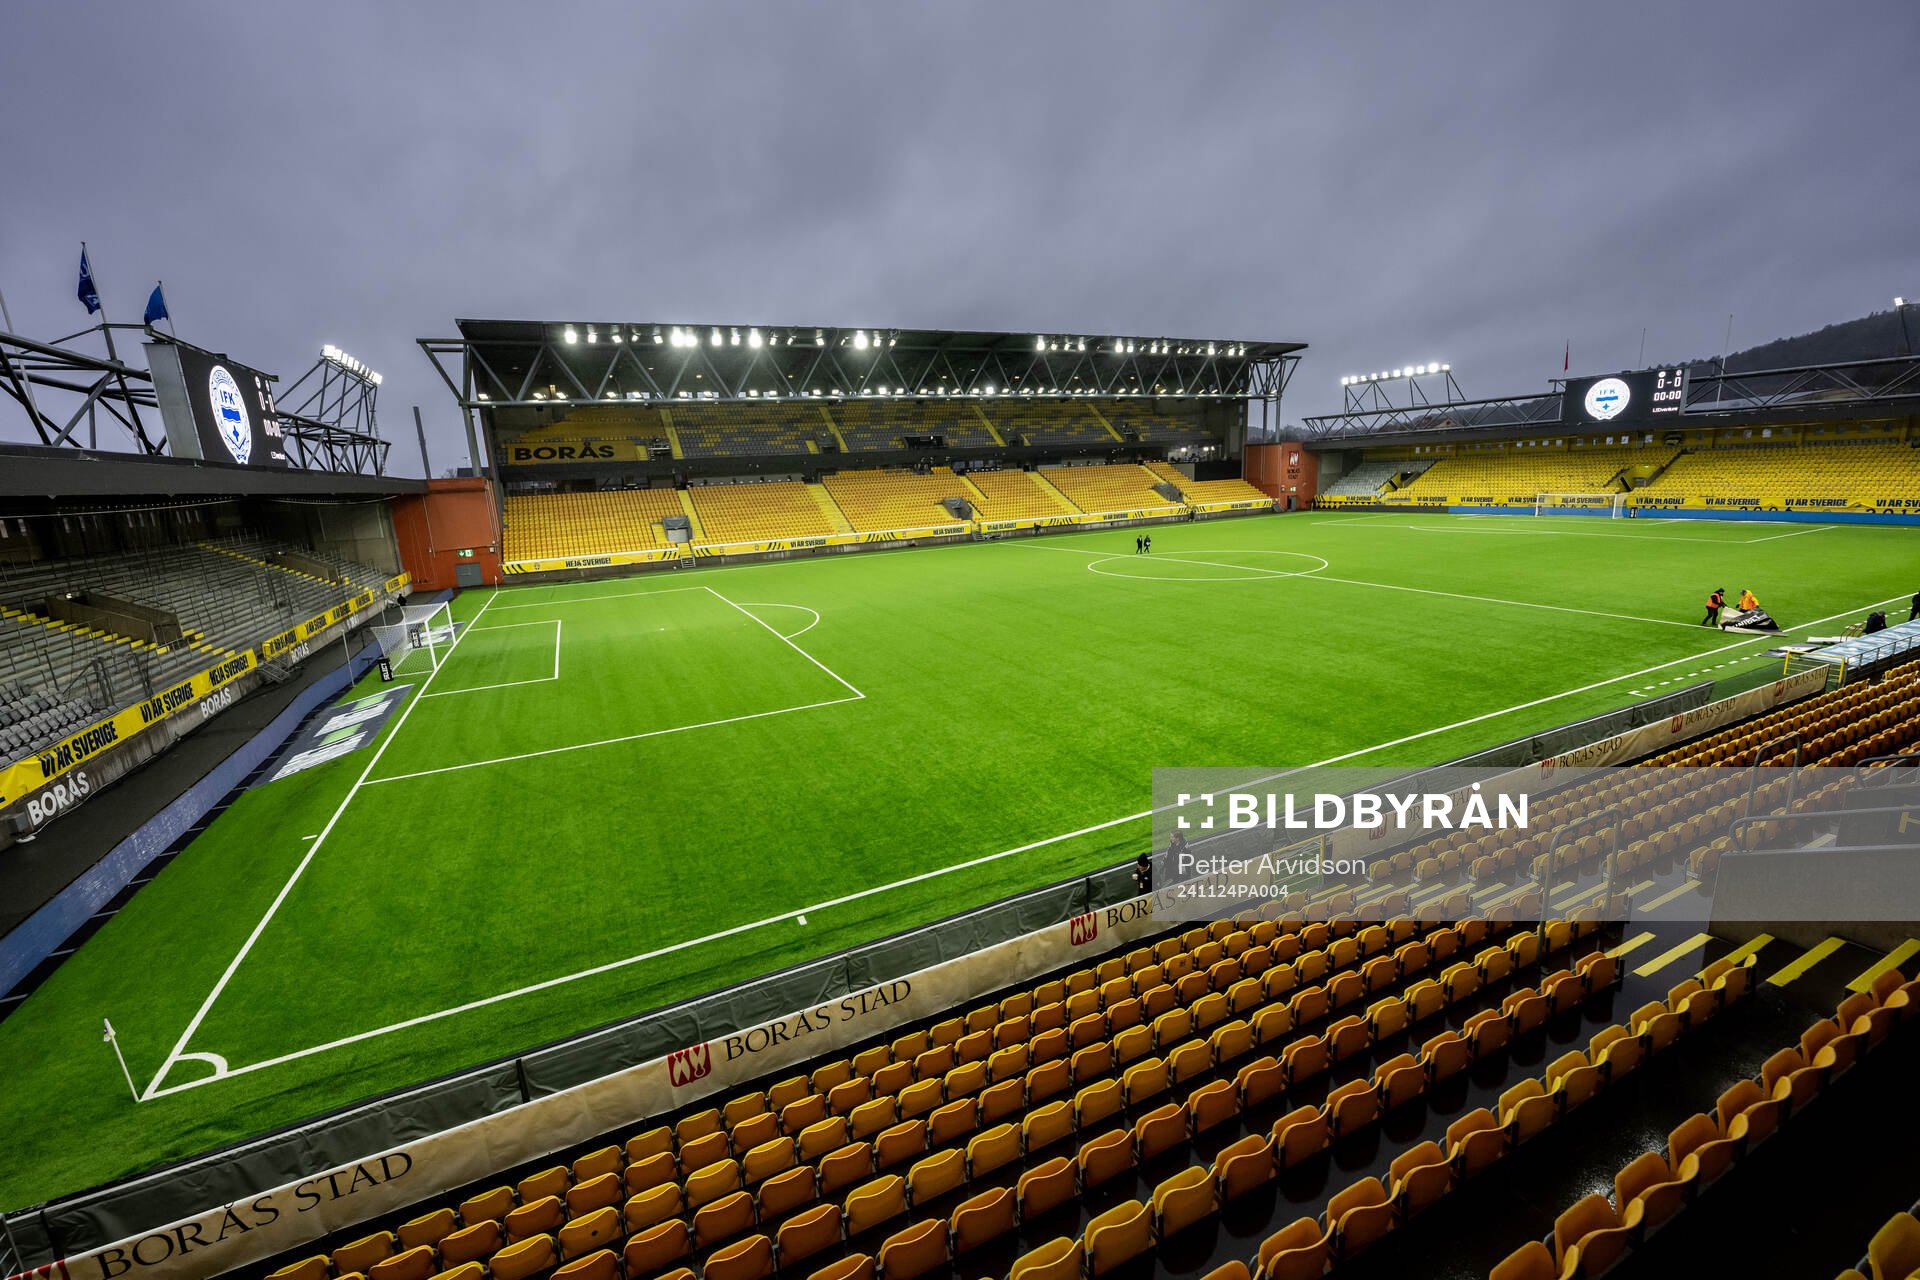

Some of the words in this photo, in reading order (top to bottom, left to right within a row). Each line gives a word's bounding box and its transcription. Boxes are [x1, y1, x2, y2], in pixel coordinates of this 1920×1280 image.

[220, 389, 236, 405] IFK
[514, 442, 614, 461] BORÅS
[1727, 498, 1760, 506] SVERIGE
[1809, 499, 1848, 507] SVERIGE
[1876, 499, 1887, 507] VI
[565, 560, 582, 568] HEJA
[582, 558, 611, 566] SVERIGE!
[209, 666, 223, 687] HEJA
[223, 655, 249, 679] SVERIGE!
[140, 703, 153, 724] VI
[151, 697, 165, 718] ÄR
[162, 682, 194, 711] SVERIGE
[200, 687, 232, 719] BORÅS
[40, 753, 57, 778] VI
[54, 744, 75, 770] ÄR
[71, 721, 119, 760] SVERIGE
[27, 770, 90, 826] BORÅS
[723, 1004, 831, 1062] BORÅS
[840, 979, 912, 1022] STAD
[92, 1195, 280, 1280] BORÅS
[294, 1151, 413, 1213] STAD
